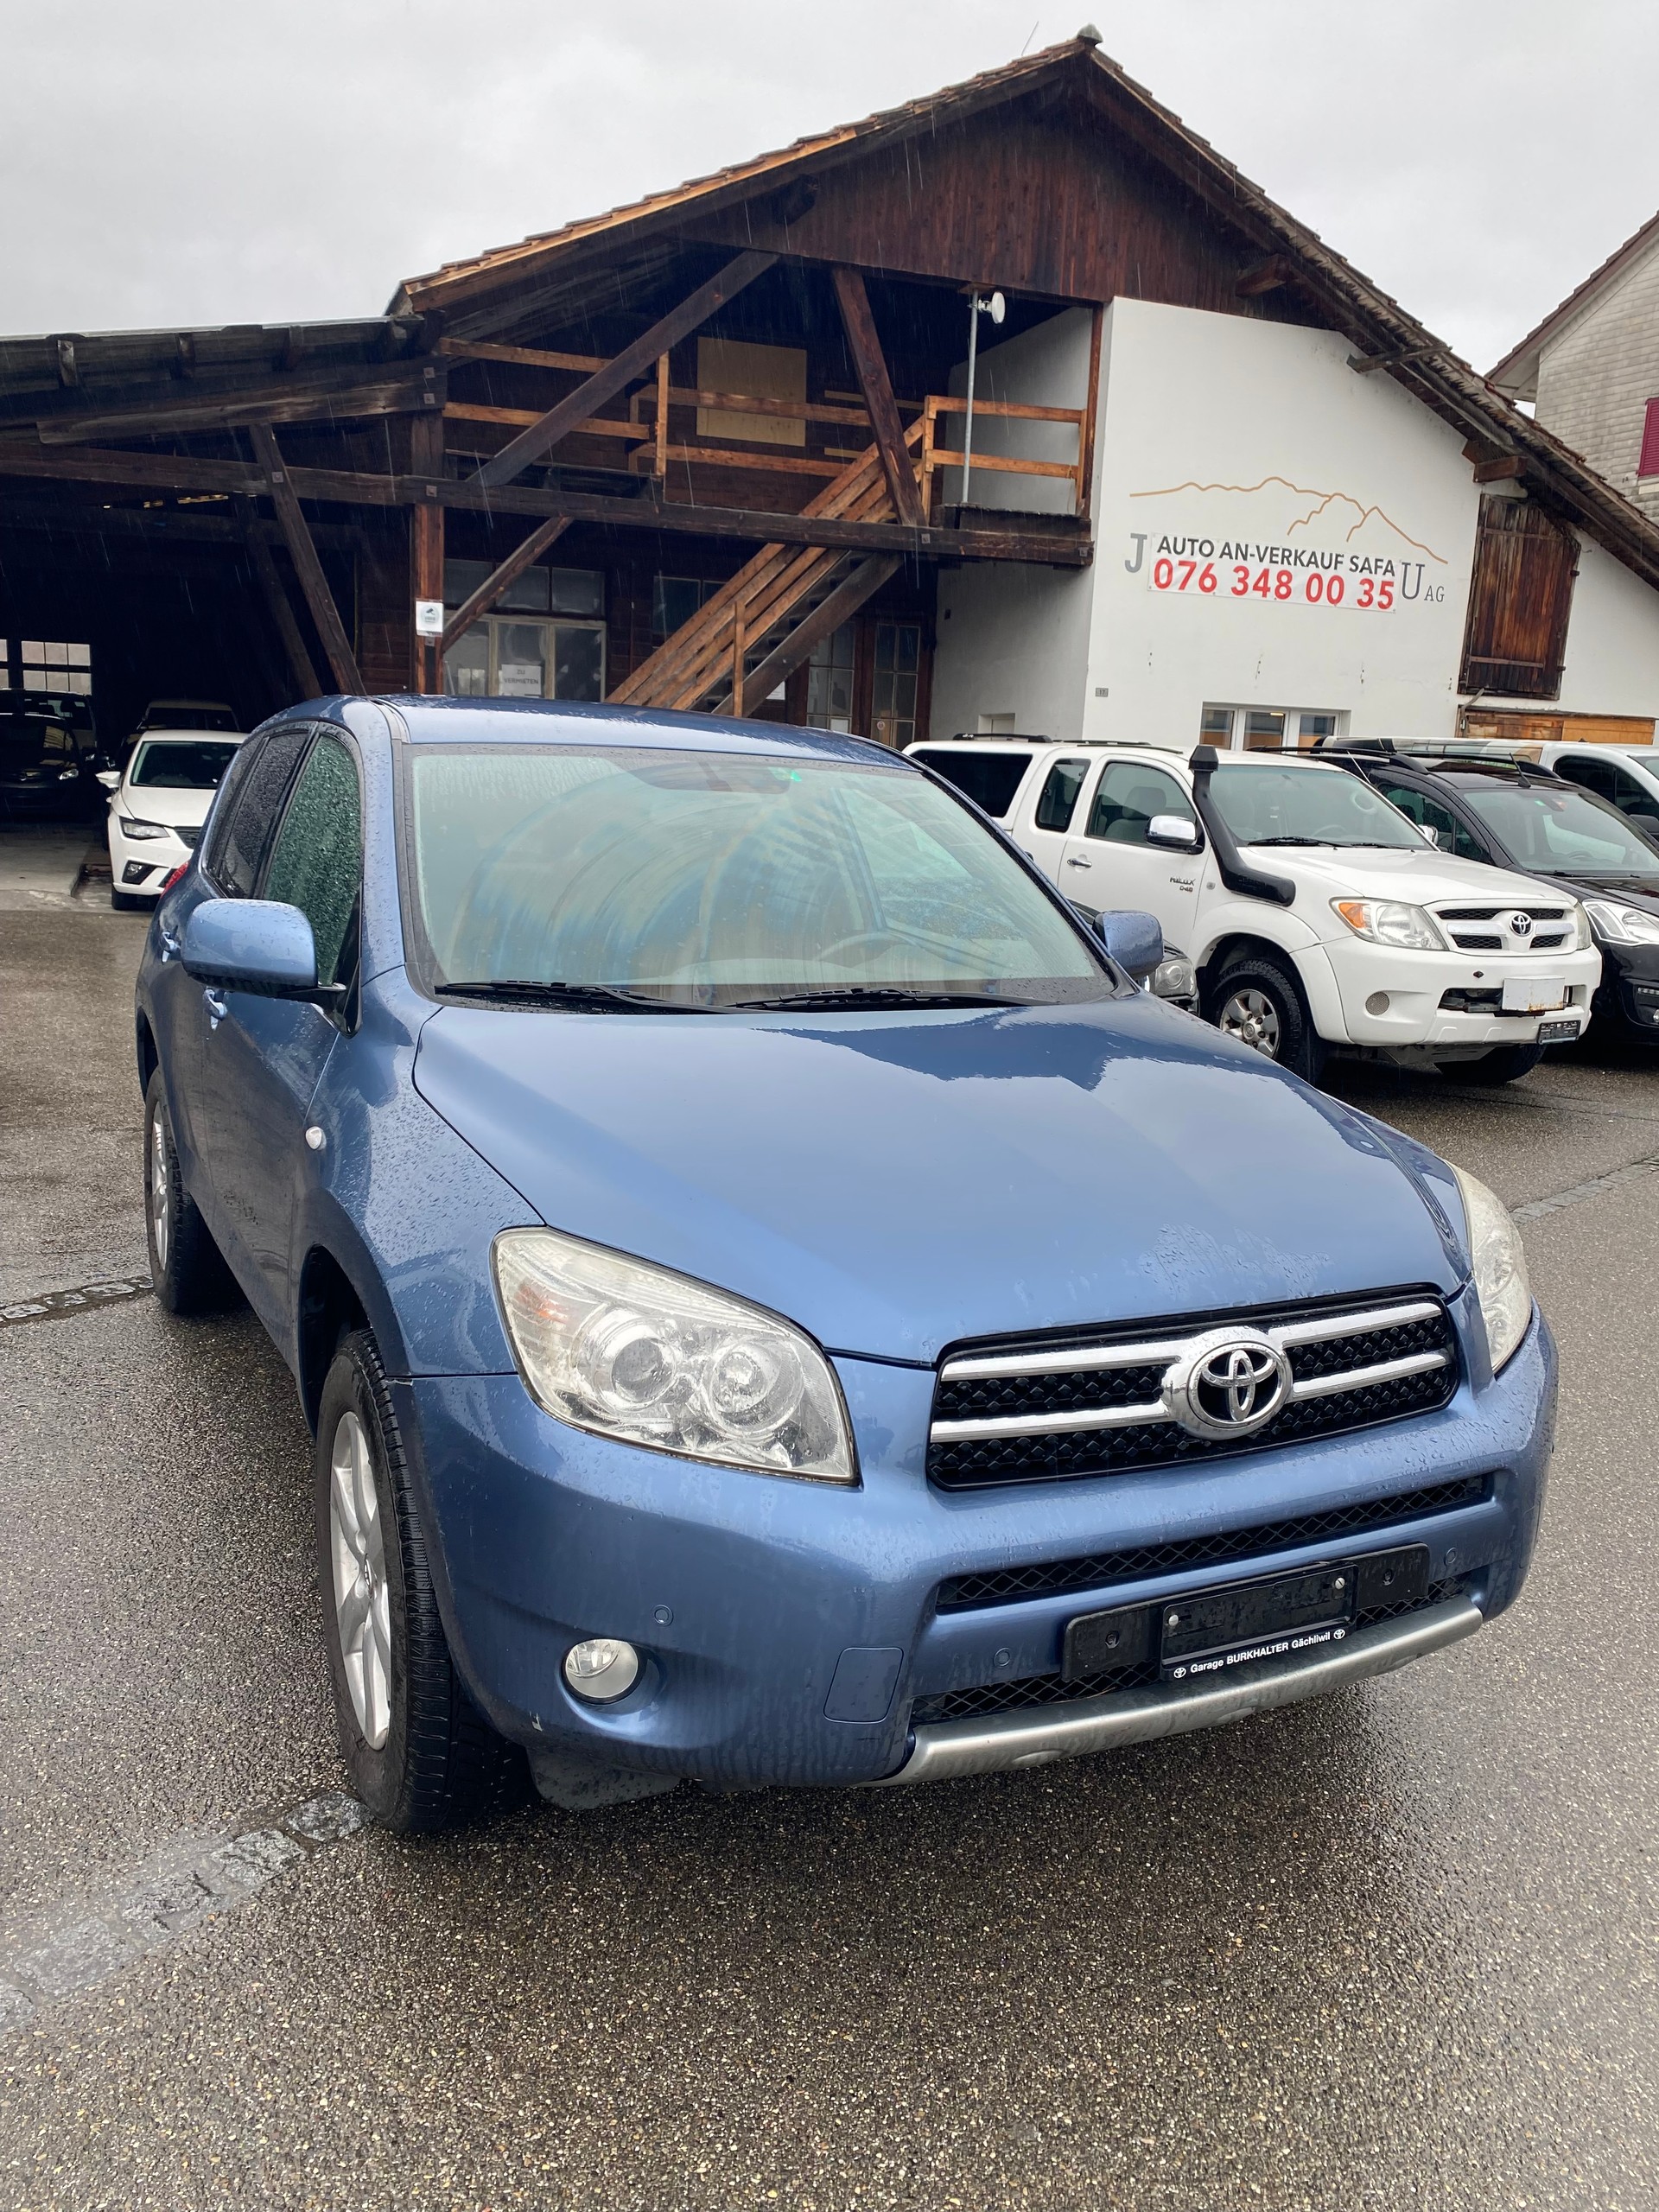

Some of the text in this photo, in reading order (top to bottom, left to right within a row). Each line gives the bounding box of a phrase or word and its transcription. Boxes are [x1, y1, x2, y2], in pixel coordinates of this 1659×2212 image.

[1125, 533, 1147, 573] J
[1157, 536, 1395, 576] AUTO AN-VERKAUF SAFA
[1154, 558, 1395, 609] 076 348 00 35
[1402, 562, 1445, 602] U AG
[1190, 1631, 1331, 1673] Garage BURKHALTER Gächliwil
